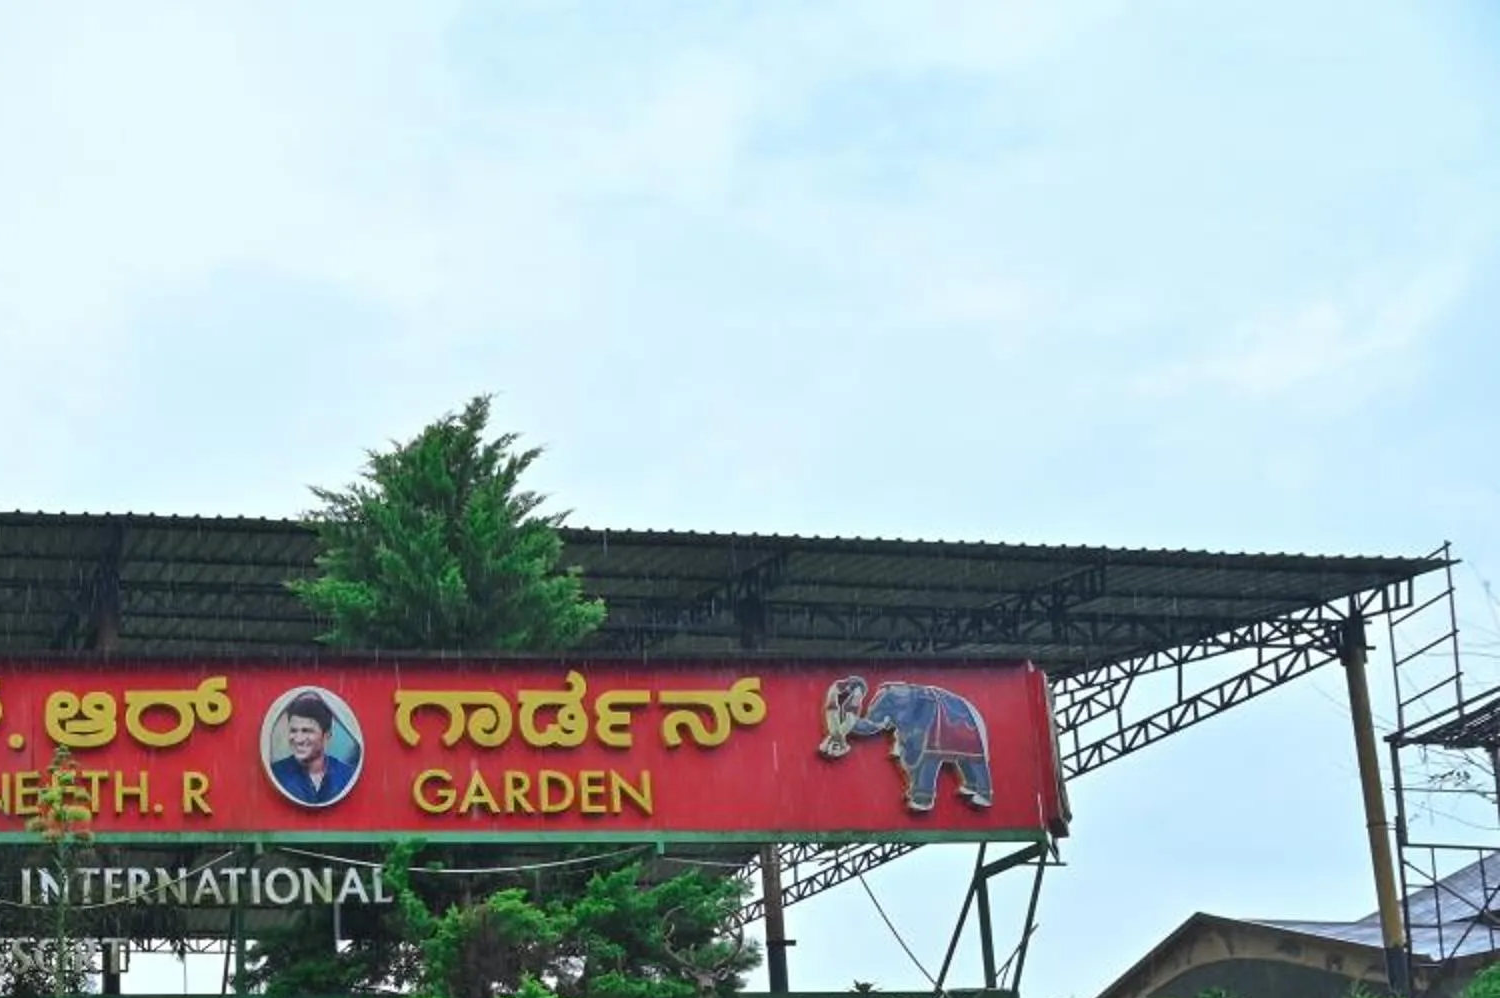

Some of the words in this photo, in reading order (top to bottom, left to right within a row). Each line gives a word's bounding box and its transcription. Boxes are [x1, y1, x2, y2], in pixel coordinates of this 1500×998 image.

[45, 676, 232, 747] ಆರ್
[183, 770, 213, 815] R
[412, 768, 653, 815] GARDEN
[21, 866, 393, 905] INTERNATIONAL
